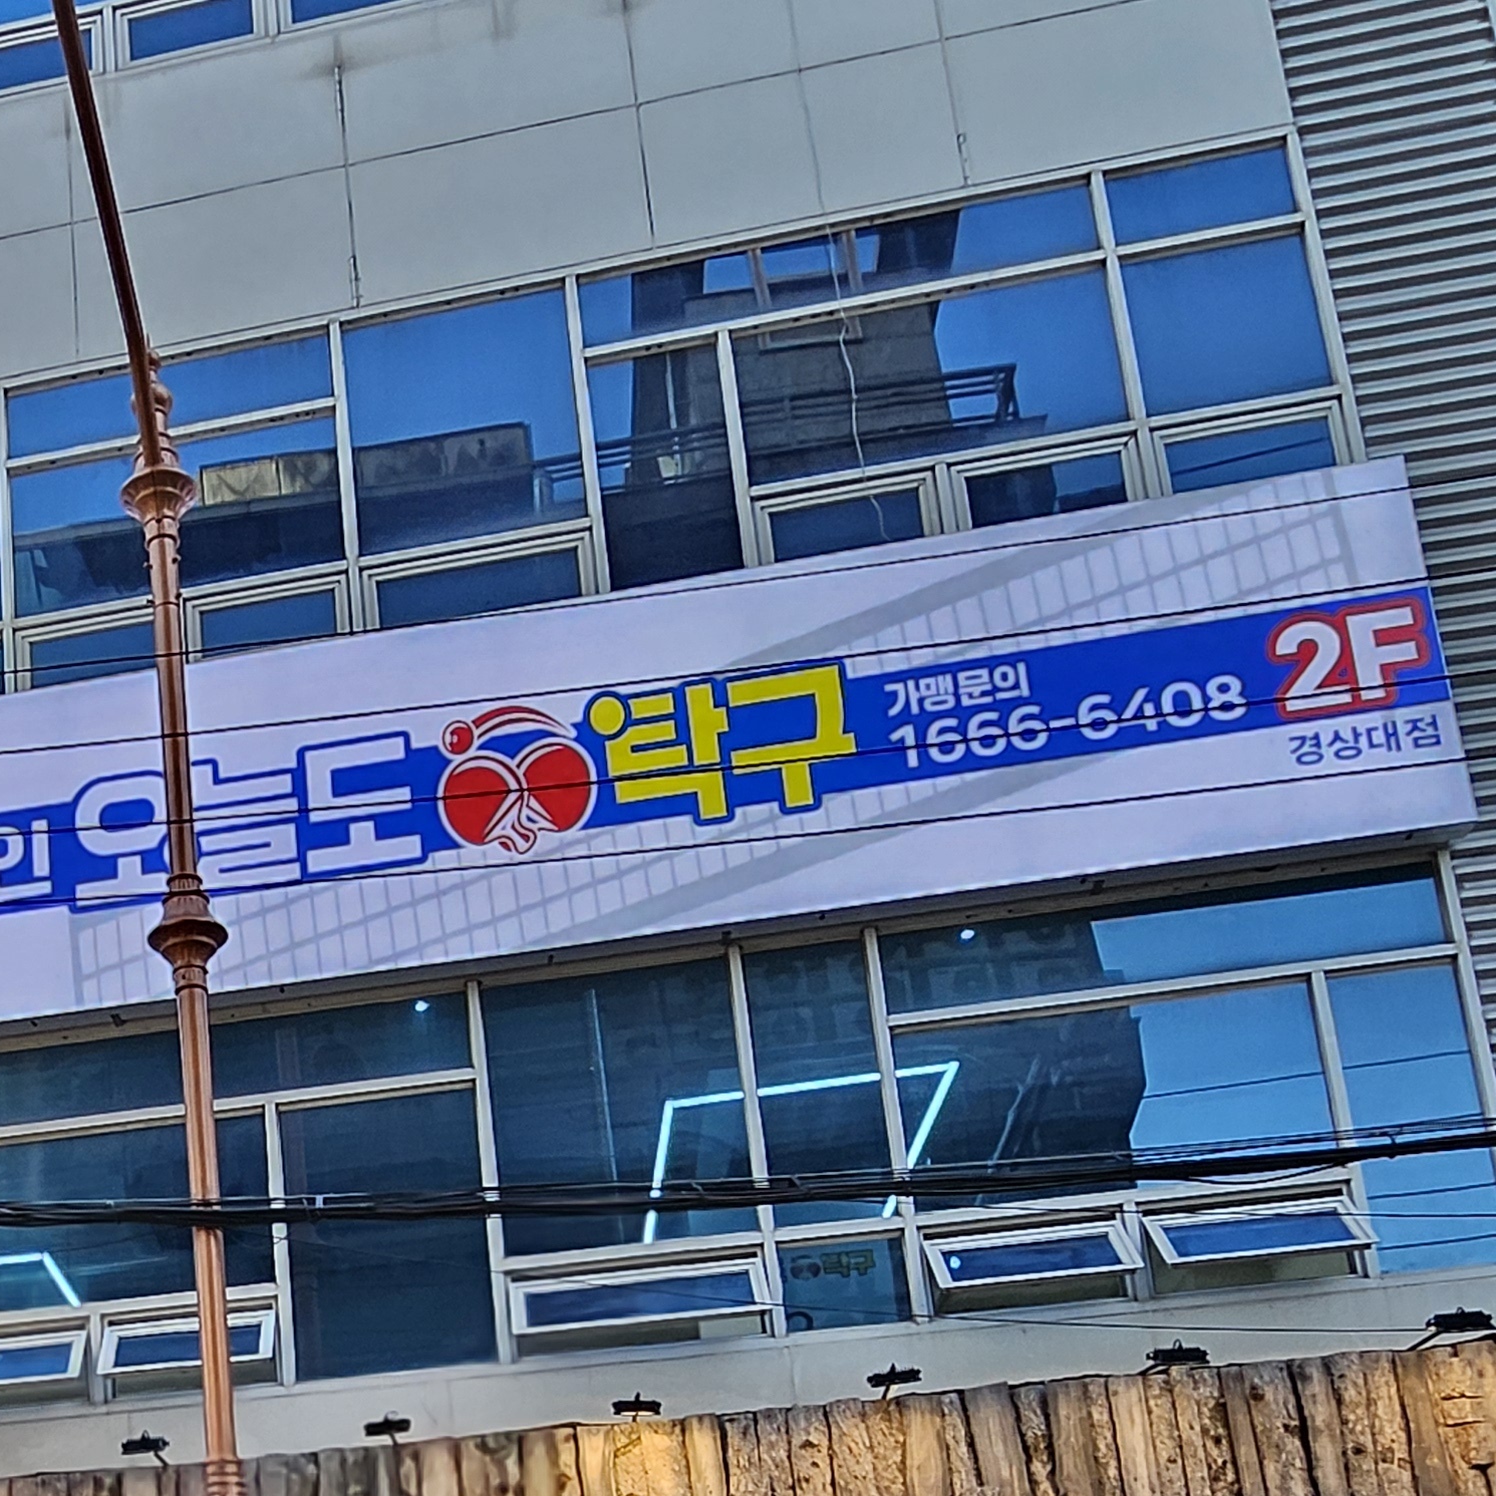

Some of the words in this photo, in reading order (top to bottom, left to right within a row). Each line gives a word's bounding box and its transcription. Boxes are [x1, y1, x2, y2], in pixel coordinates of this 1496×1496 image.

[883, 661, 1031, 718] 가맹문의
[1270, 602, 1424, 715] 2F
[888, 674, 1248, 769] 1666-6408
[1289, 714, 1443, 766] 경상대점
[72, 733, 423, 908] 오늘도
[588, 665, 857, 821] 탁구
